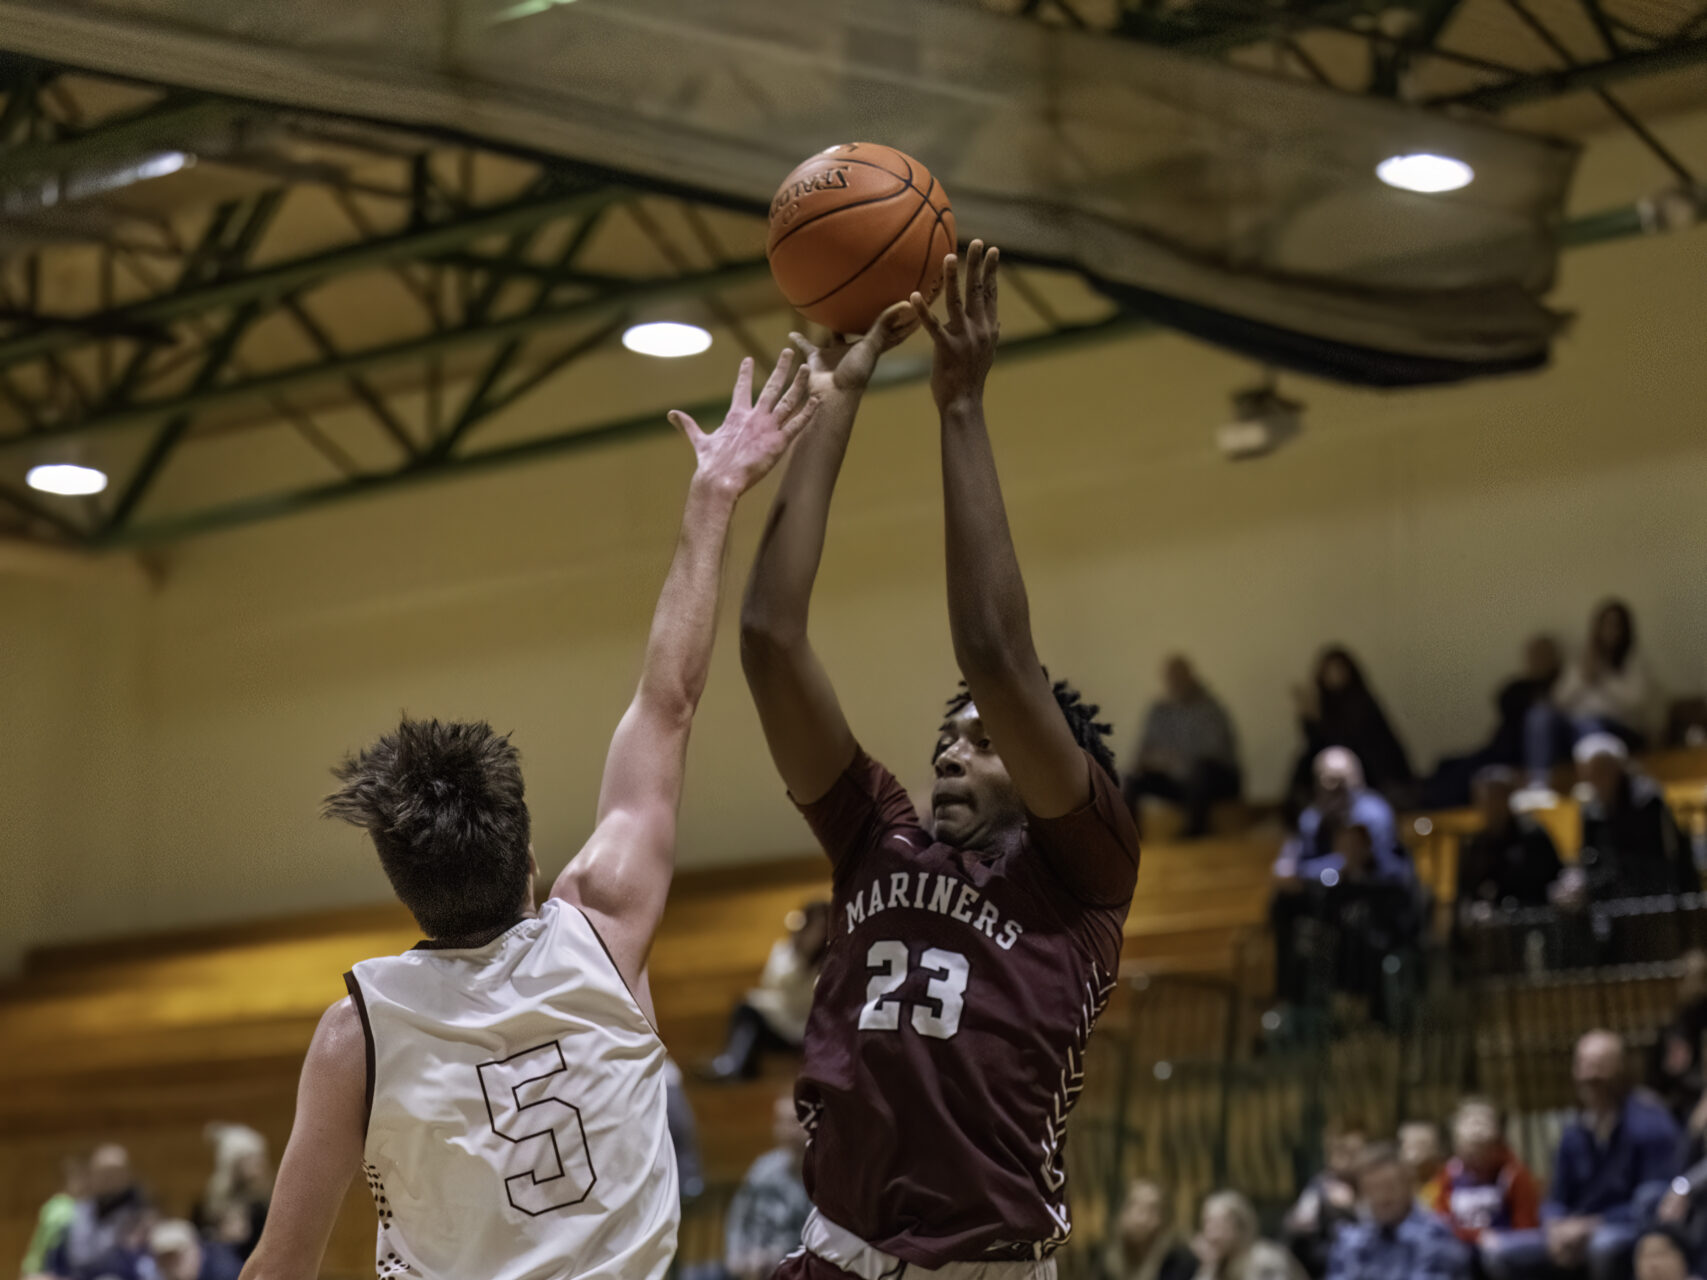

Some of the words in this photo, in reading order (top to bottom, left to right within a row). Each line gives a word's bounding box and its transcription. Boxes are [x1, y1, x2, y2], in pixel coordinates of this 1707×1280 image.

[845, 872, 1023, 951] MARINERS
[858, 940, 970, 1040] 23
[475, 1039, 597, 1217] 5
